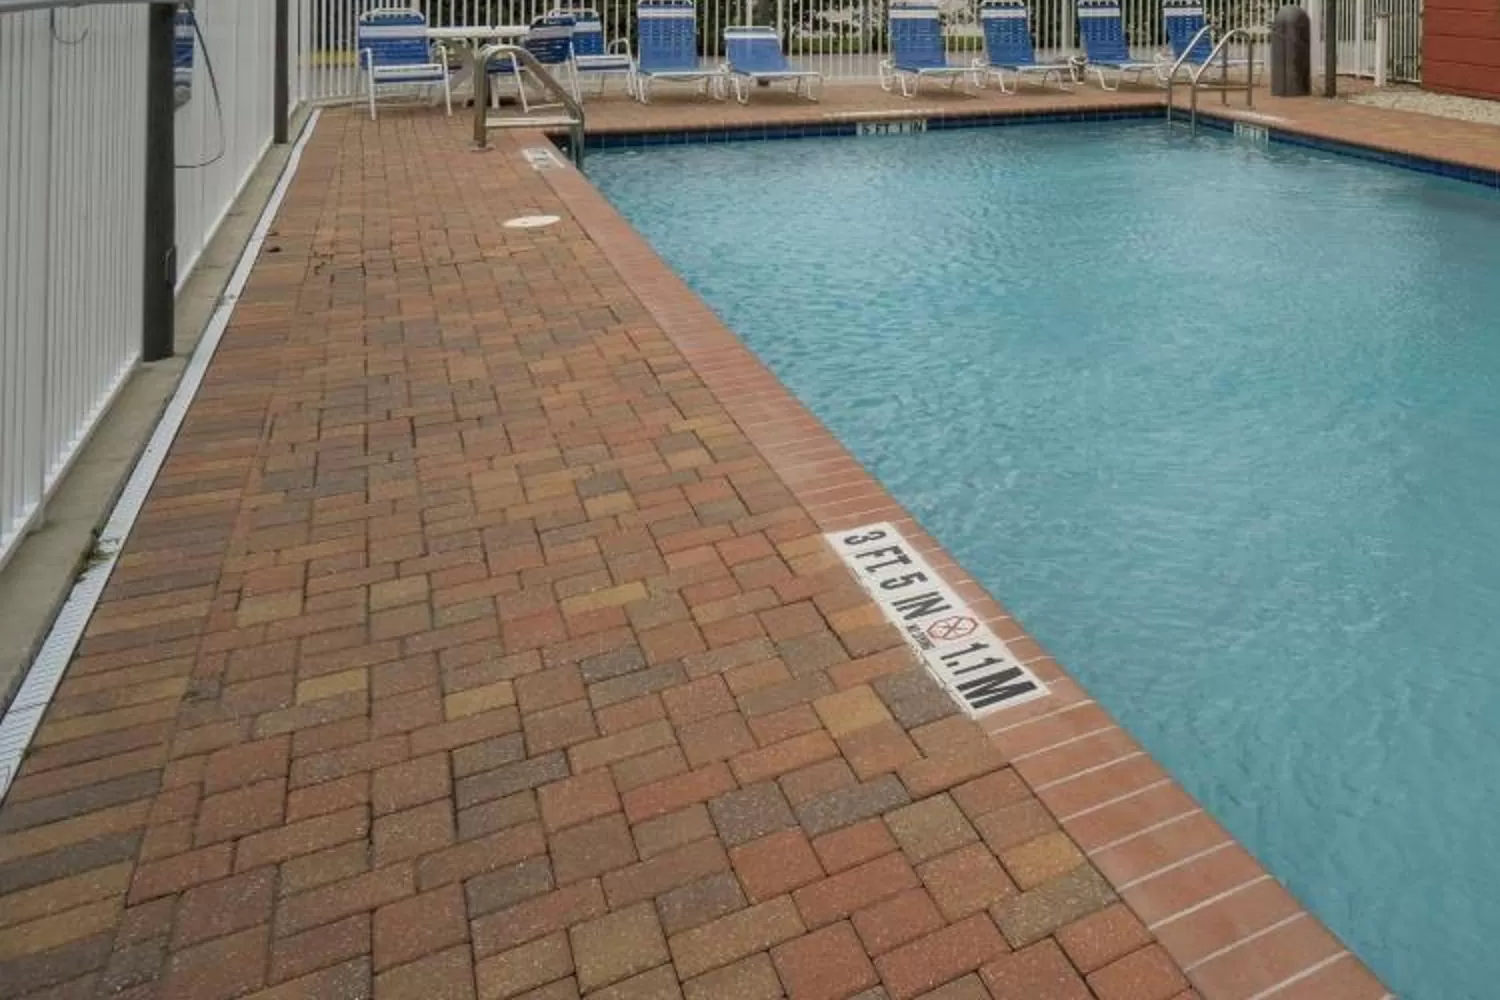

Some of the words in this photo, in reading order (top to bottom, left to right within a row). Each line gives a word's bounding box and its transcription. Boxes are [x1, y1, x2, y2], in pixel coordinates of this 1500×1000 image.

[843, 530, 888, 545] 3
[880, 571, 929, 591] 5
[891, 591, 953, 621] IN
